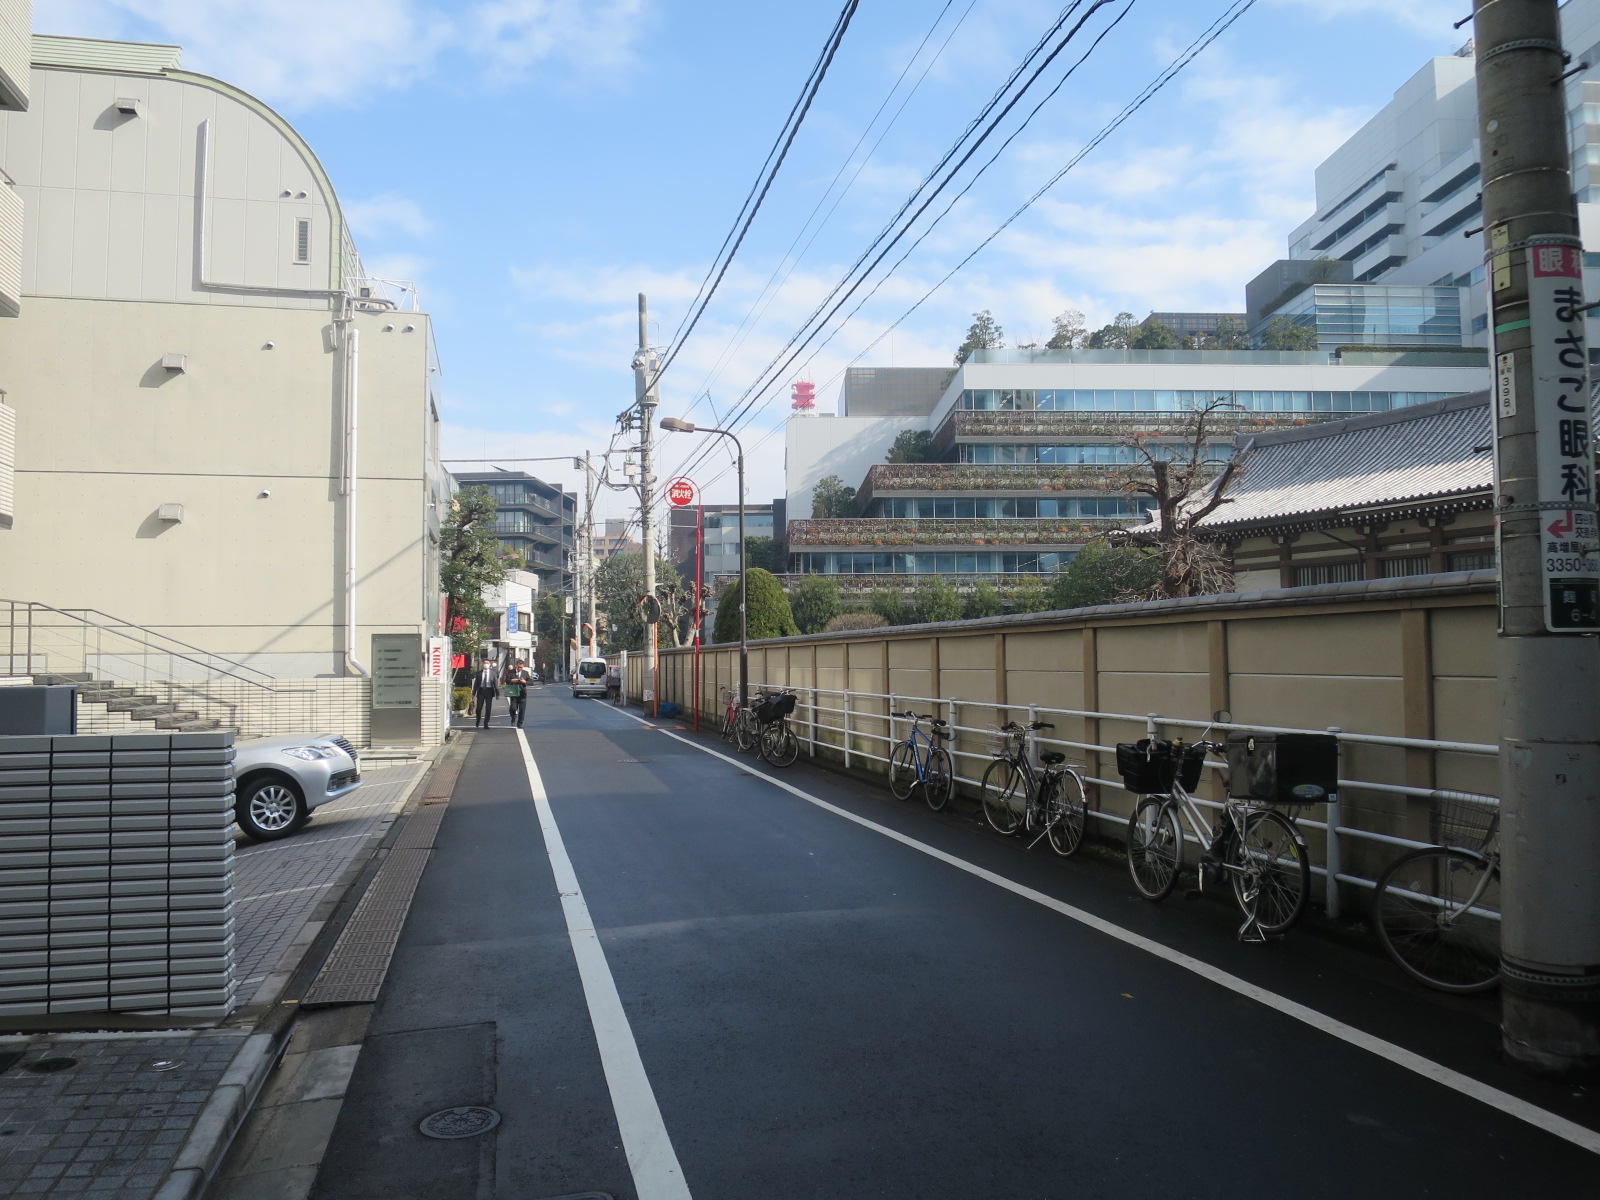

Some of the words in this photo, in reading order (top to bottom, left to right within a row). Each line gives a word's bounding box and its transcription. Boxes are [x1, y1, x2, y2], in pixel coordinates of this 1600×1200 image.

[671, 488, 692, 499] 消火栓
[433, 646, 441, 676] KIRIN
